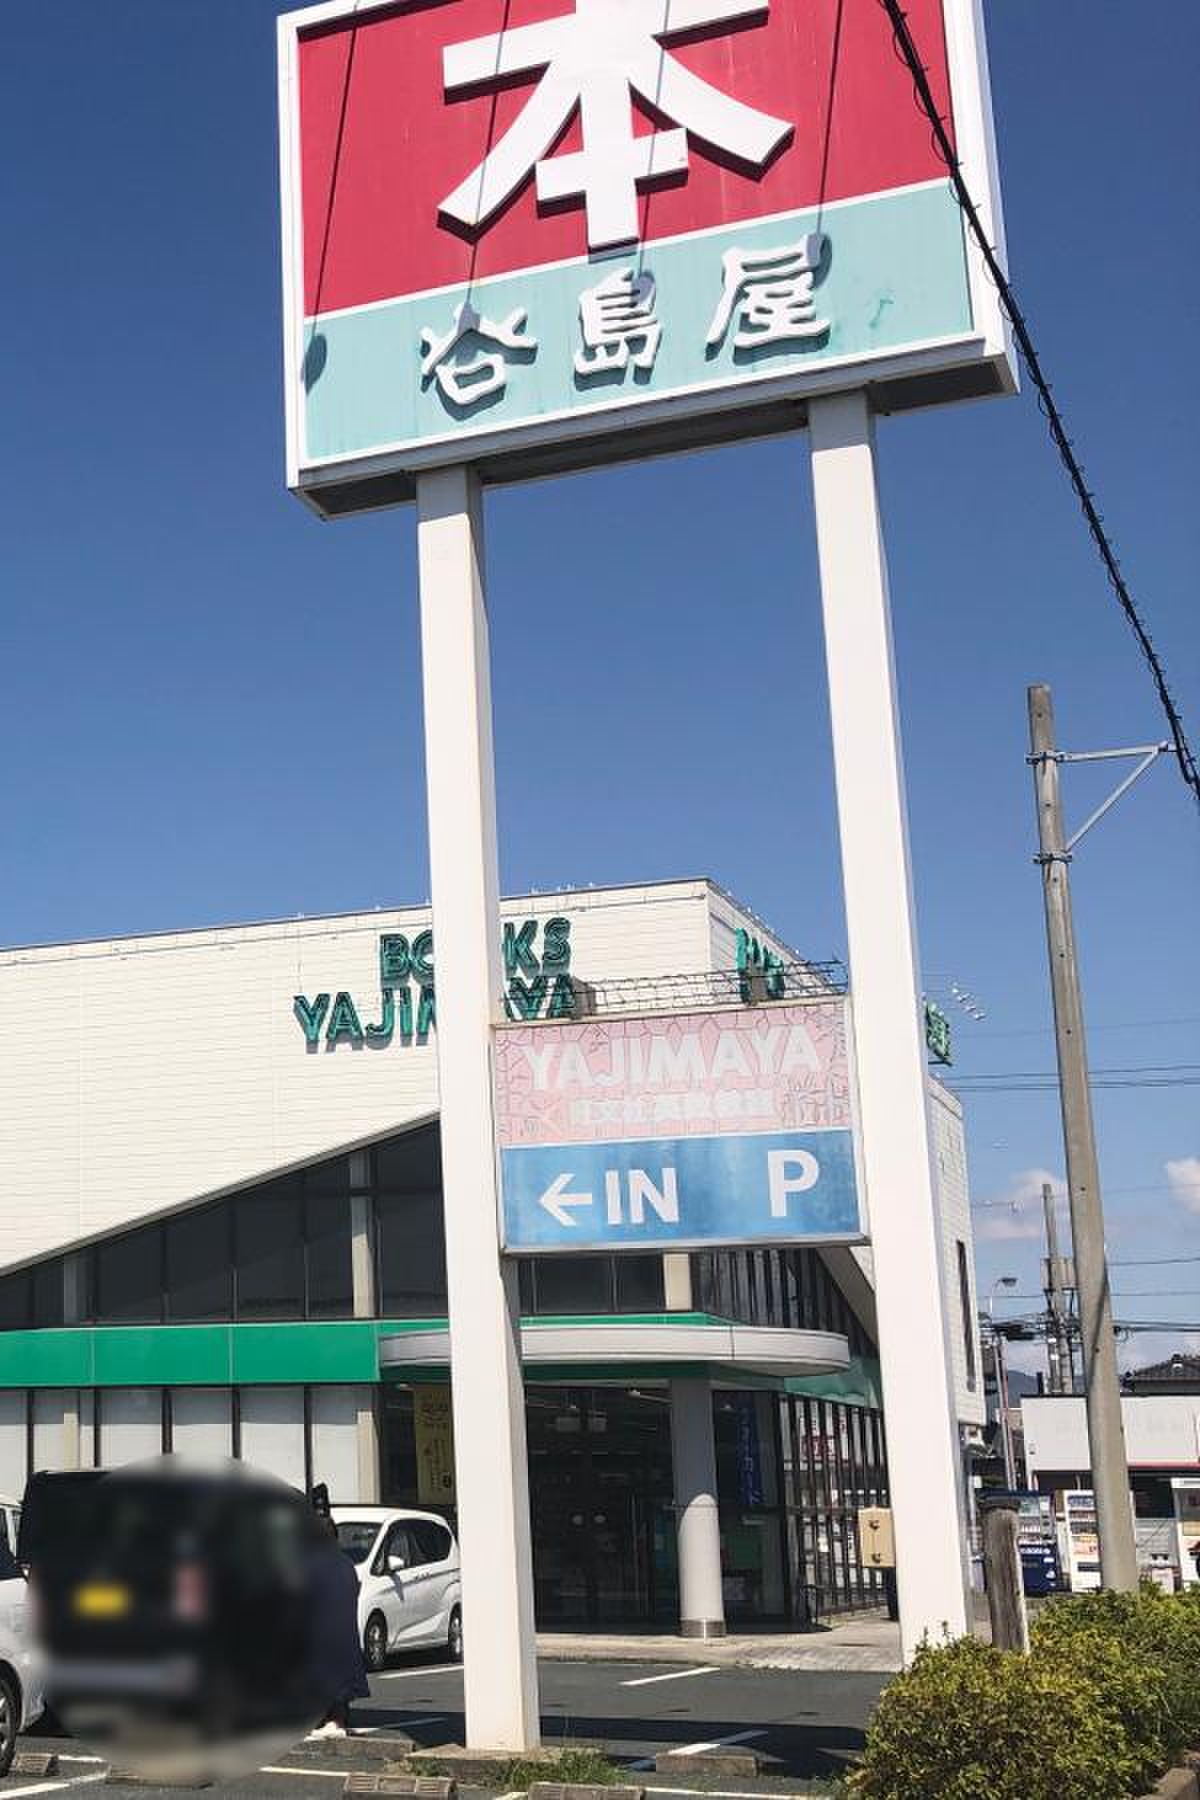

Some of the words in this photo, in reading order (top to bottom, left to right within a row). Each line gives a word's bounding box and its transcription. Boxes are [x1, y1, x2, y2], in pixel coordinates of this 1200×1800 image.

[437, 0, 794, 249] 本
[420, 233, 831, 407] 谷島屋
[524, 1023, 818, 1090] YAJIMAYA
[605, 1168, 680, 1225] IN
[767, 1150, 820, 1217] P
